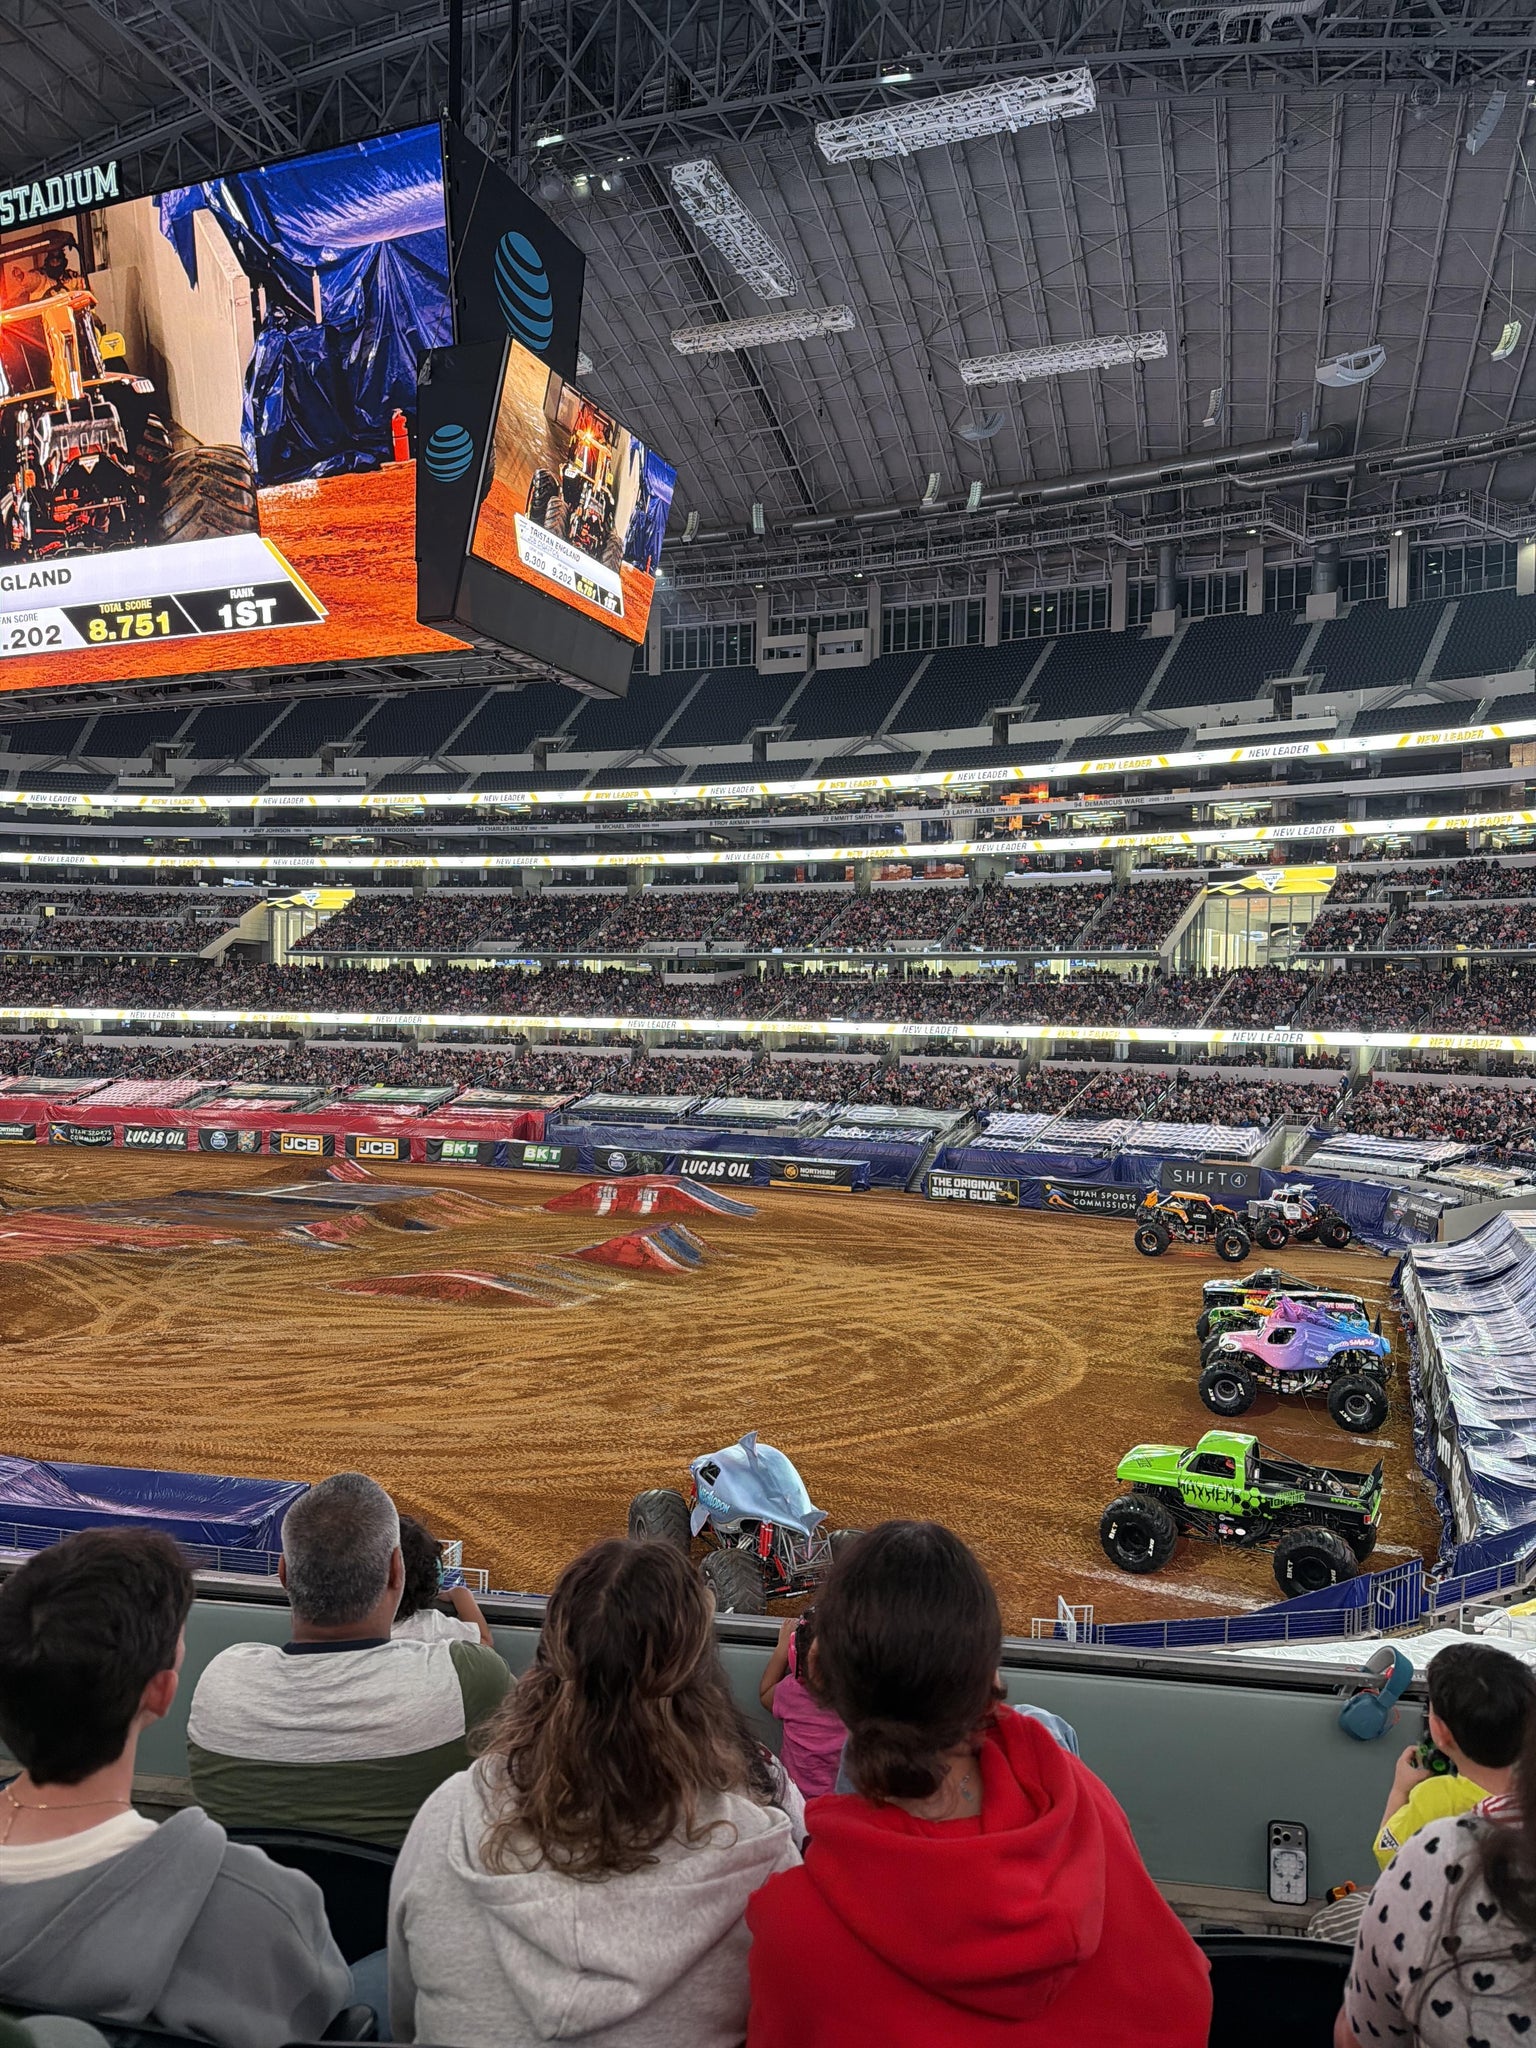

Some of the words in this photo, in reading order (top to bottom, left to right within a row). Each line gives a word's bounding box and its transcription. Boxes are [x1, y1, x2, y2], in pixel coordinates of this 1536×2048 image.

[0, 161, 119, 225] STADIUM
[530, 527, 554, 546] TRISTAN
[555, 541, 580, 562] ENGLAND
[524, 552, 546, 570] 8.300
[552, 567, 572, 585] 9.202
[1, 568, 72, 591] GLAND
[229, 587, 255, 599] RANK
[99, 601, 123, 613] TOTAL
[125, 599, 152, 611] SCORE
[218, 598, 277, 628] 1ST
[14, 613, 39, 623] SCORE
[88, 611, 170, 642] 8.751
[1416, 733, 1441, 745] NEW
[1443, 729, 1484, 742] LEADER
[1249, 748, 1269, 758] NEW
[1271, 745, 1309, 756] LEADER
[1095, 762, 1116, 771] NEW
[1119, 759, 1152, 770] LEADER
[957, 772, 975, 781] NEW
[978, 770, 1008, 779] LEADER
[728, 786, 755, 794] LEADER
[30, 794, 48, 802] NEW
[49, 795, 77, 803] LEADER
[952, 808, 973, 816] LARRY
[1445, 818, 1469, 829] NEW
[1472, 815, 1514, 828] LEADER
[1273, 828, 1294, 837] NEW
[1295, 825, 1335, 835] LEADER
[975, 844, 995, 852] NEW
[996, 842, 1027, 851] LEADER
[725, 853, 742, 861] NEW
[743, 852, 770, 860] LEADER
[627, 1020, 645, 1028] NEW
[647, 1020, 677, 1028] LEADER
[902, 1025, 922, 1033] NEW
[925, 1026, 958, 1034] LEADER
[1232, 1032, 1257, 1041] NEW
[1260, 1033, 1303, 1043] LEADER
[1428, 1037, 1455, 1047] NEW
[1457, 1038, 1503, 1048] LEADER
[70, 1134, 112, 1142] COMMISSION
[125, 1130, 163, 1144] LUCAS
[165, 1131, 186, 1146] OIL
[284, 1137, 320, 1151] JCB
[359, 1141, 395, 1155] JCB
[442, 1141, 478, 1155] BKT
[524, 1147, 561, 1161] BKT
[681, 1159, 726, 1177] LUCAS
[728, 1161, 751, 1178] OIL
[800, 1167, 836, 1176] NORTHERN
[931, 1176, 953, 1187] THE
[953, 1177, 1003, 1191] ORIGINAL
[1173, 1169, 1228, 1186] SHIFT
[931, 1186, 967, 1199] SUPER
[969, 1189, 997, 1202] GLUE
[1073, 1190, 1097, 1198] UTAH
[1101, 1191, 1137, 1202] SPORTS
[1073, 1198, 1136, 1210] COMMISSION
[1339, 1410, 1352, 1422] BKT
[1179, 1481, 1236, 1507] MAYHEM
[1108, 1521, 1118, 1540] BKT
[1147, 1538, 1155, 1557] BKT
[1286, 1560, 1294, 1579] BKT
